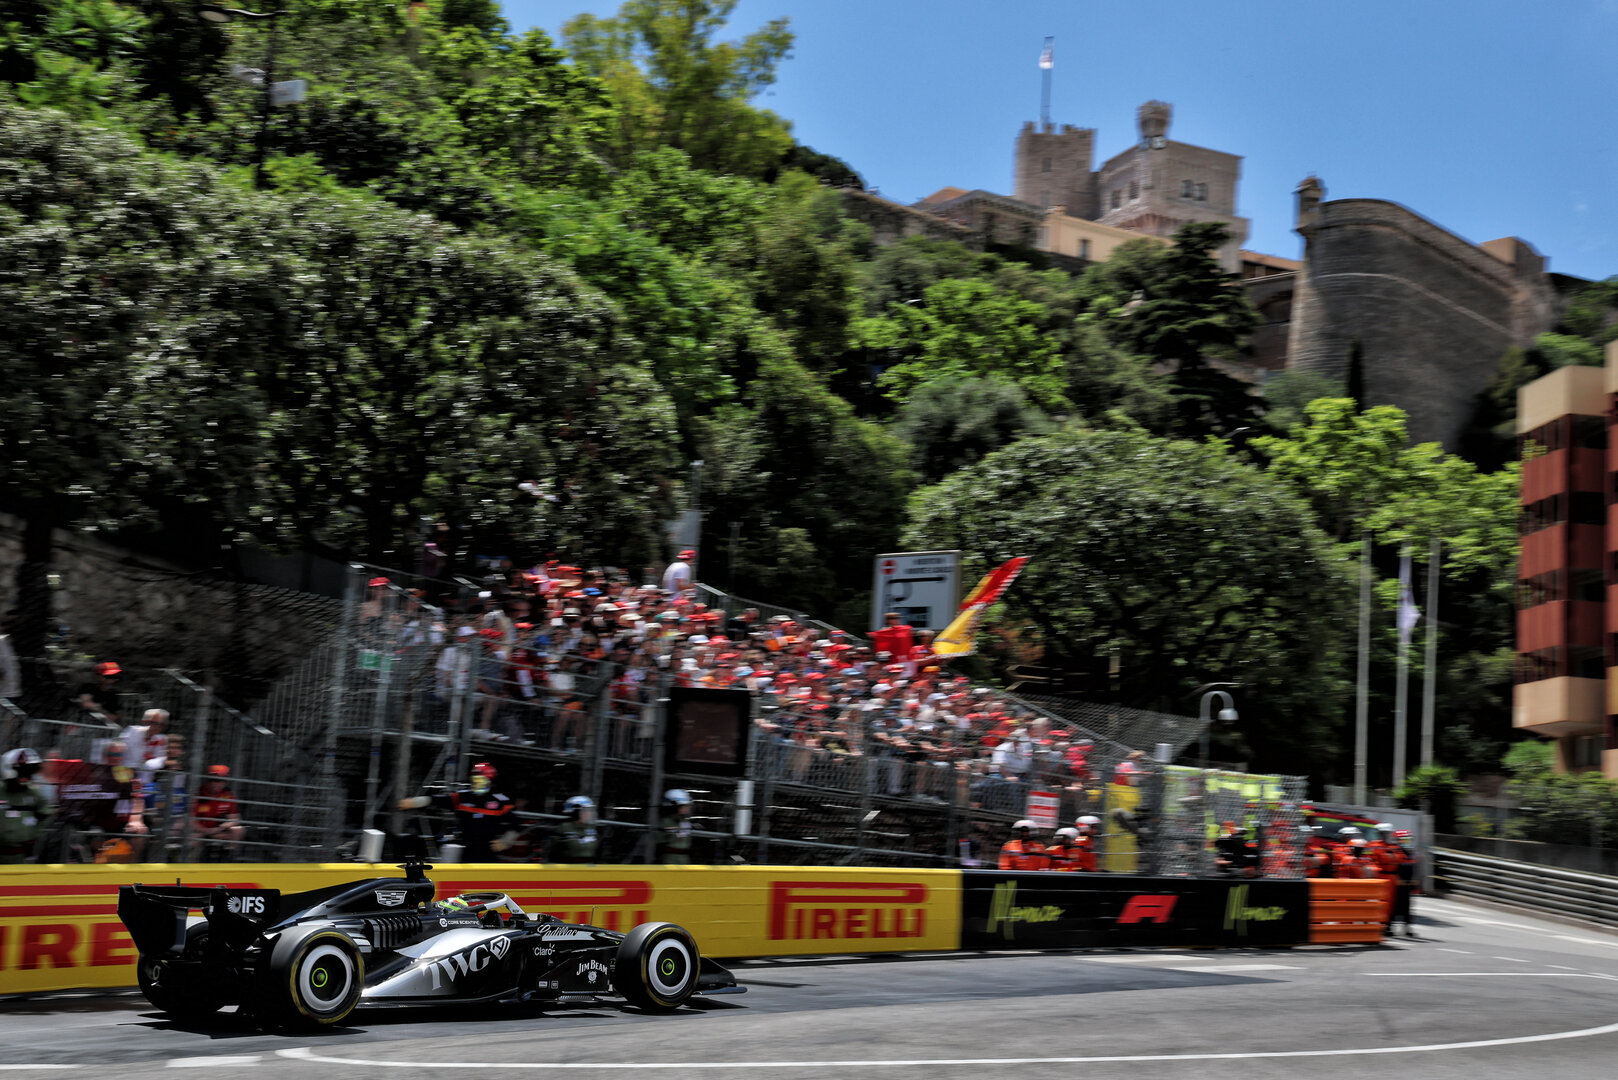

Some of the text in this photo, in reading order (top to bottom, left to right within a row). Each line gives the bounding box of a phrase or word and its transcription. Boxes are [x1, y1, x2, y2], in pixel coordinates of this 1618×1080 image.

[242, 896, 265, 914] IFS
[769, 882, 927, 940] PIRELLI
[537, 924, 578, 937] Cadillac
[534, 946, 553, 956] Claro
[422, 943, 491, 991] TWG
[576, 960, 608, 976] JIM BEAM
